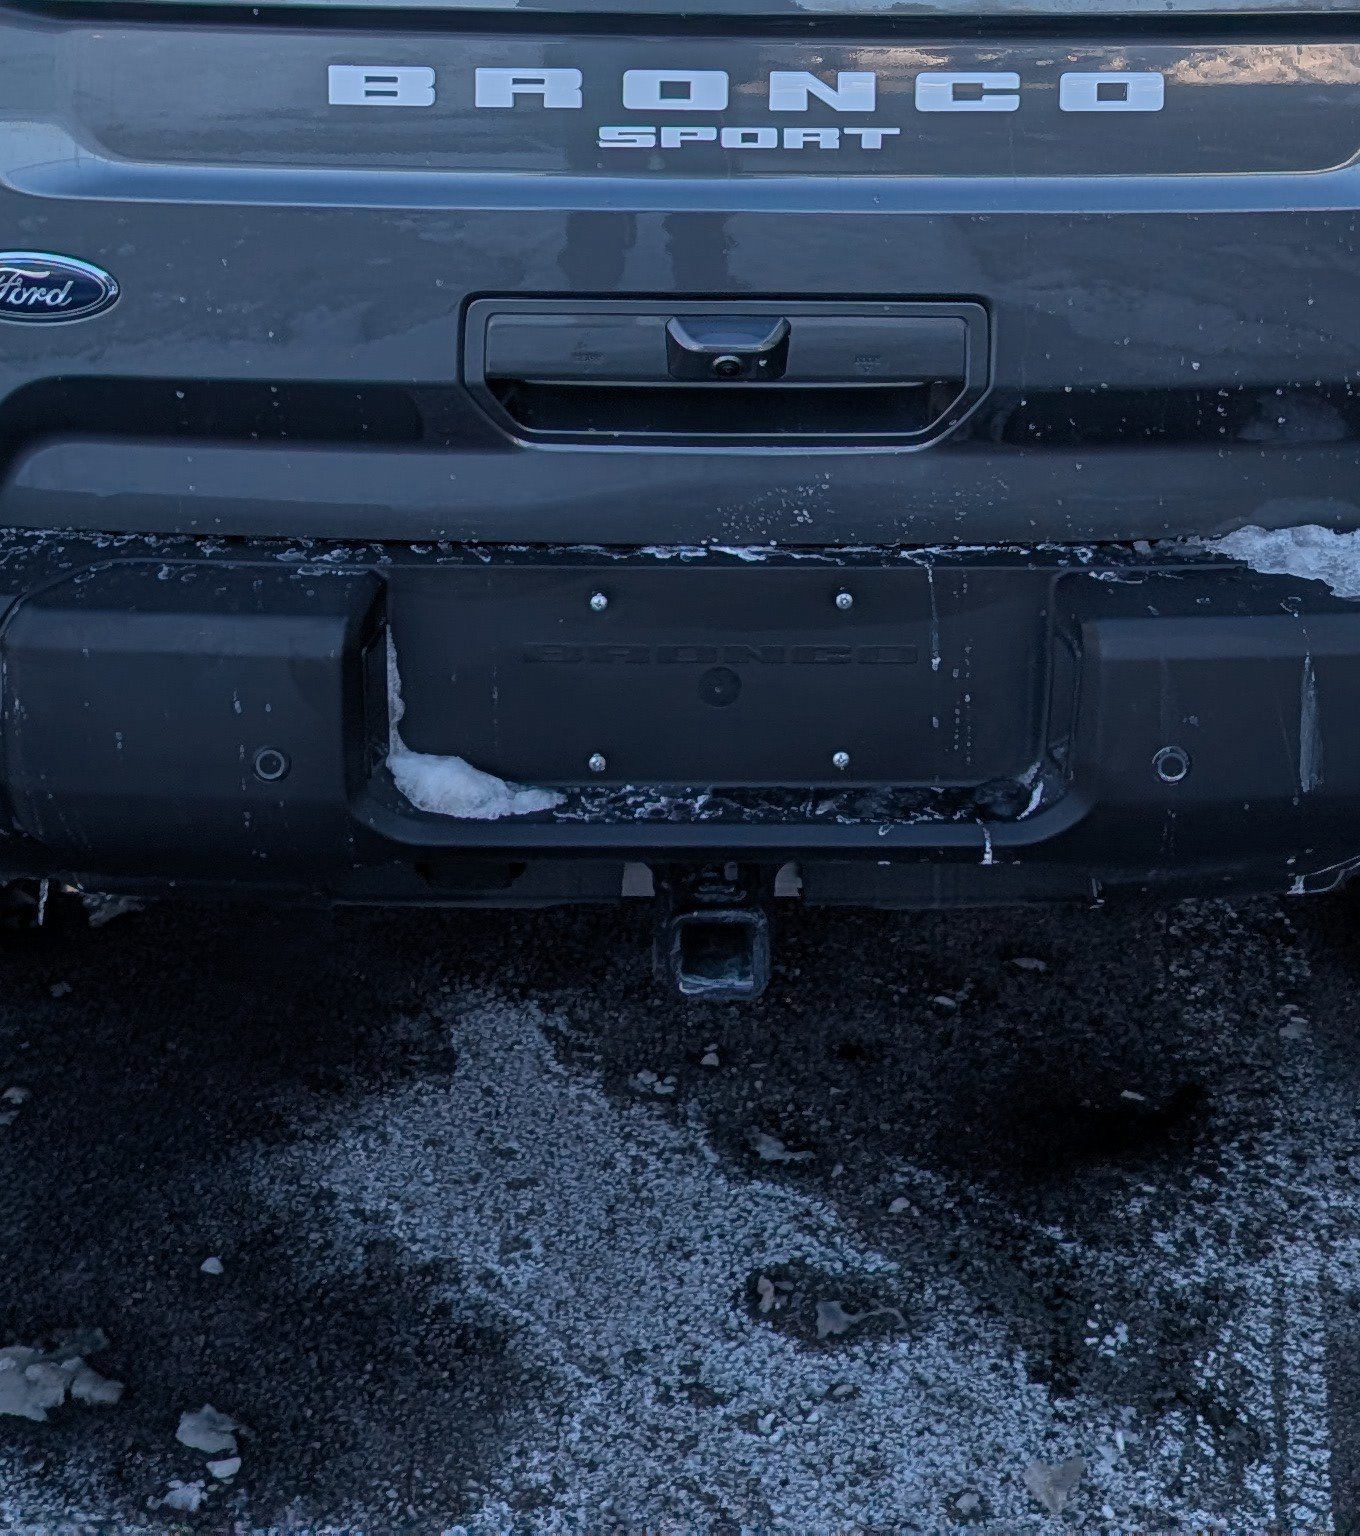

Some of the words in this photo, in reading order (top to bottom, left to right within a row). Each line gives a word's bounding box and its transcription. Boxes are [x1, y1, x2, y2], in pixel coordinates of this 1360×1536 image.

[327, 64, 1165, 113] BRONCO
[598, 126, 901, 150] SPORT
[522, 642, 919, 665] BRONCO
